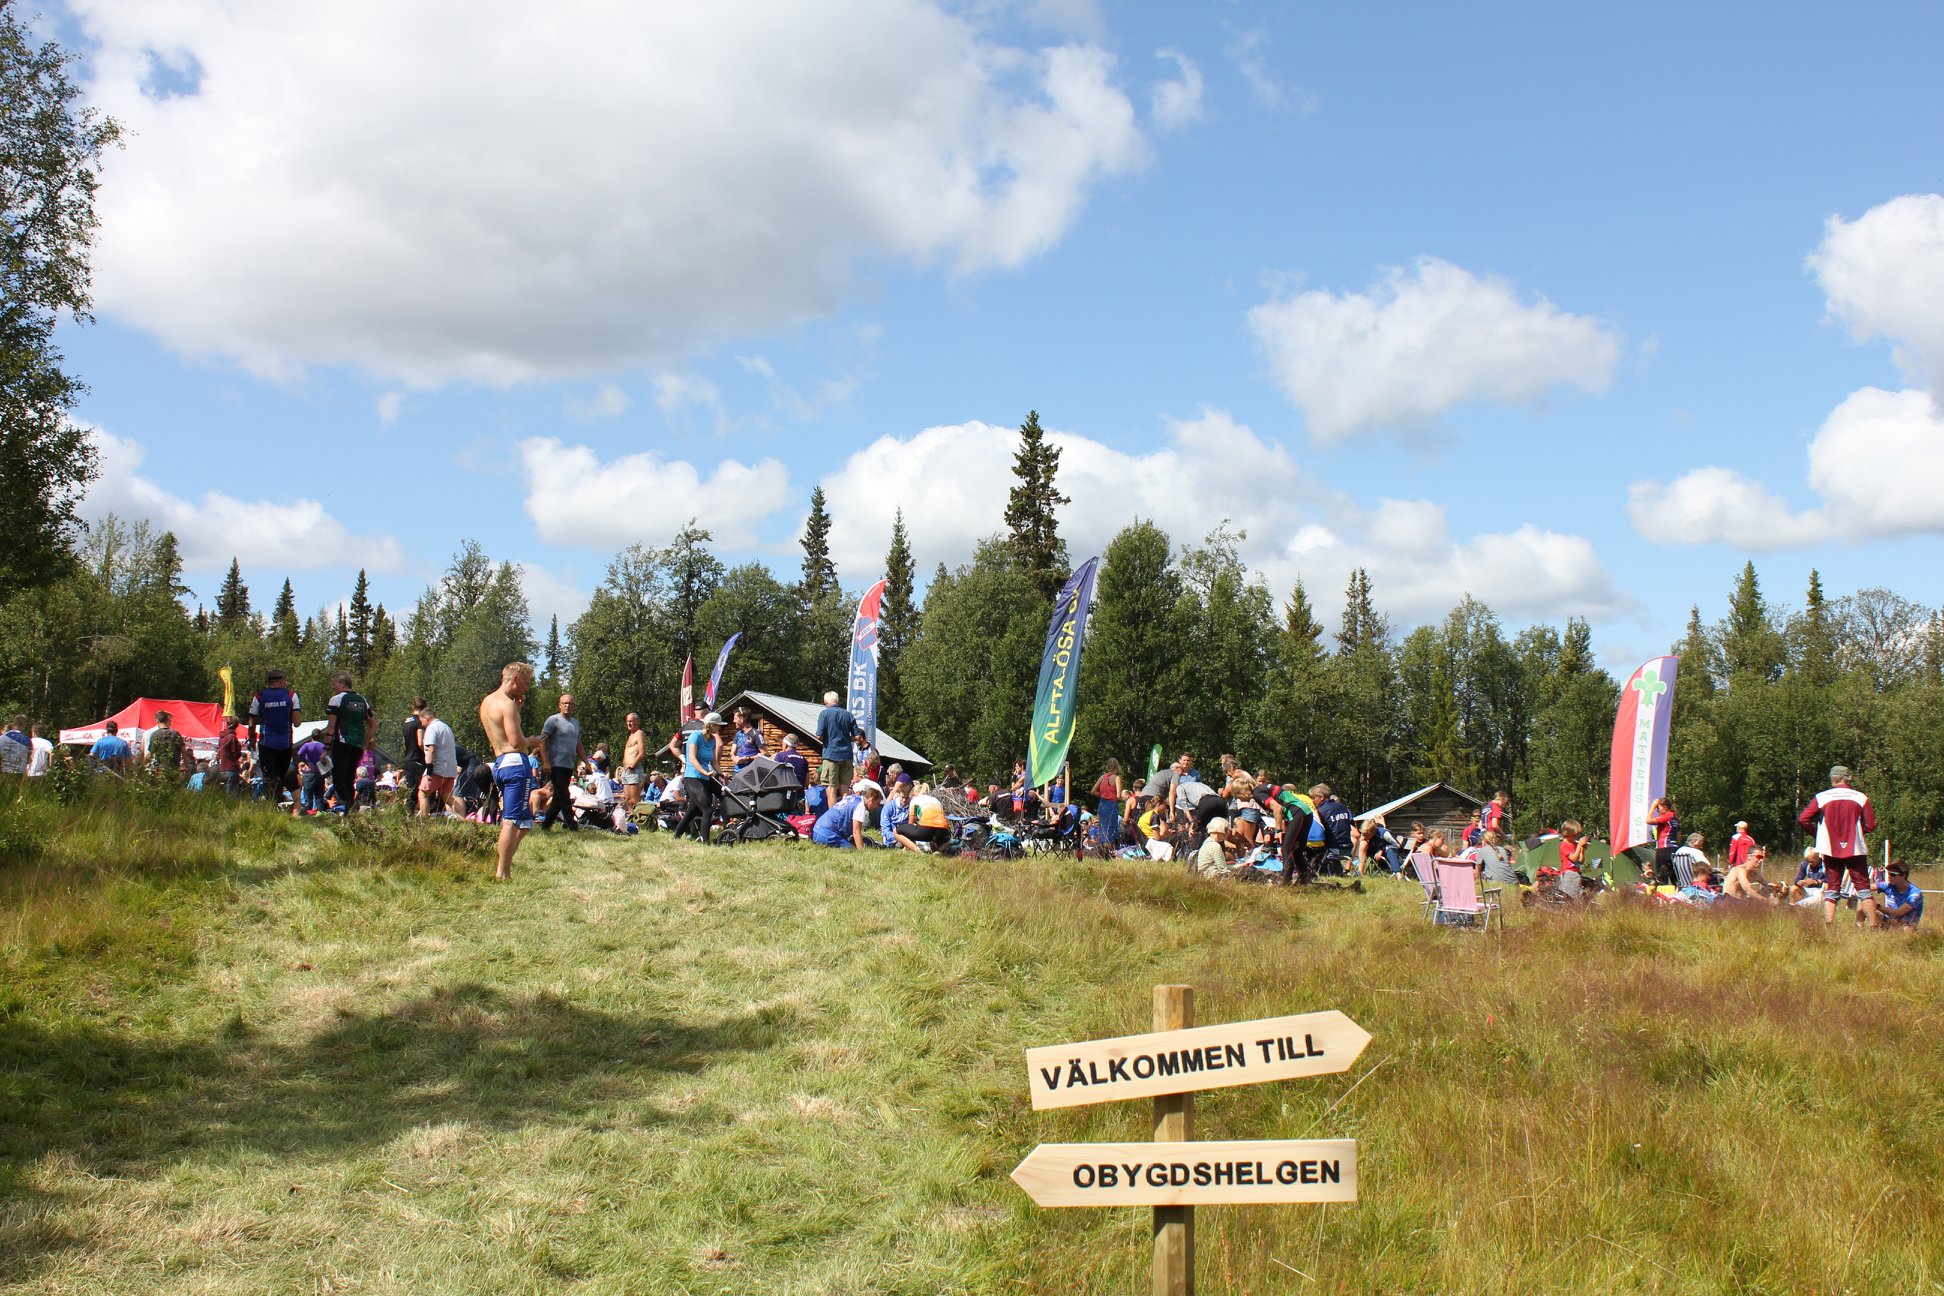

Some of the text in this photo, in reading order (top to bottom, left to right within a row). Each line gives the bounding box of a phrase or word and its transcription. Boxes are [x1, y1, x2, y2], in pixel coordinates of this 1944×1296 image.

[853, 661, 868, 692] BK
[1043, 619, 1076, 745] ALFTA-ÖSA
[1635, 718, 1651, 804] MATTEUS
[1041, 1034, 1325, 1090] VÄLKOMMEN TILL
[1072, 1160, 1341, 1188] OBYGDSHELGEN
